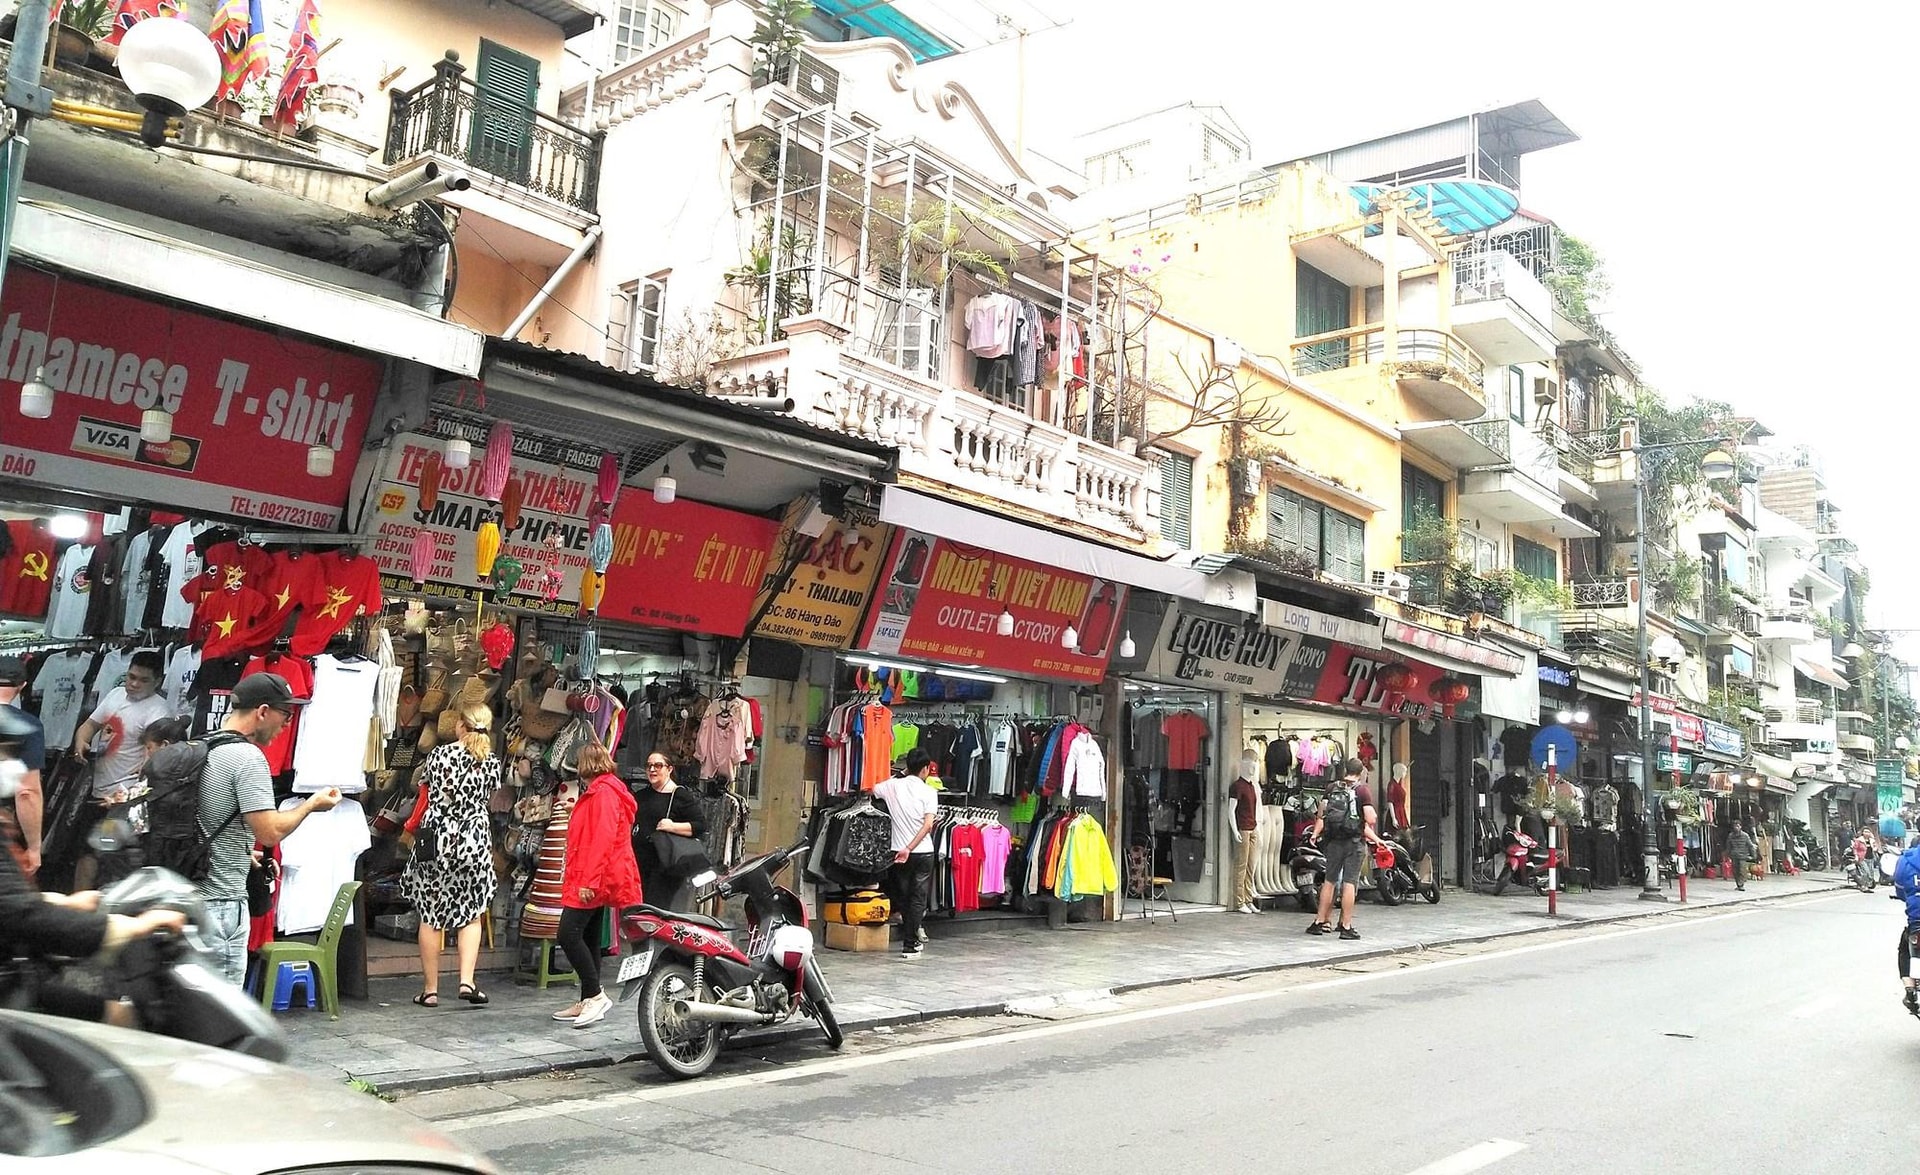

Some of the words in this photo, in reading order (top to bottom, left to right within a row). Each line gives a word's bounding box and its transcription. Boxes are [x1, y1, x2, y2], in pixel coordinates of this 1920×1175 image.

[84, 427, 130, 450] VISA
[230, 495, 256, 516] TEL:
[258, 502, 336, 530] 0927231987
[381, 493, 406, 510] CS7
[930, 550, 991, 597] MADE
[807, 582, 864, 608] THAILAND
[784, 607, 797, 621] 86
[937, 605, 998, 635] OUTLET
[1283, 606, 1311, 631] Long
[1319, 616, 1340, 639] Huy
[1168, 612, 1239, 662] LONG
[1235, 630, 1292, 672] HUY
[1180, 657, 1200, 679] 84
